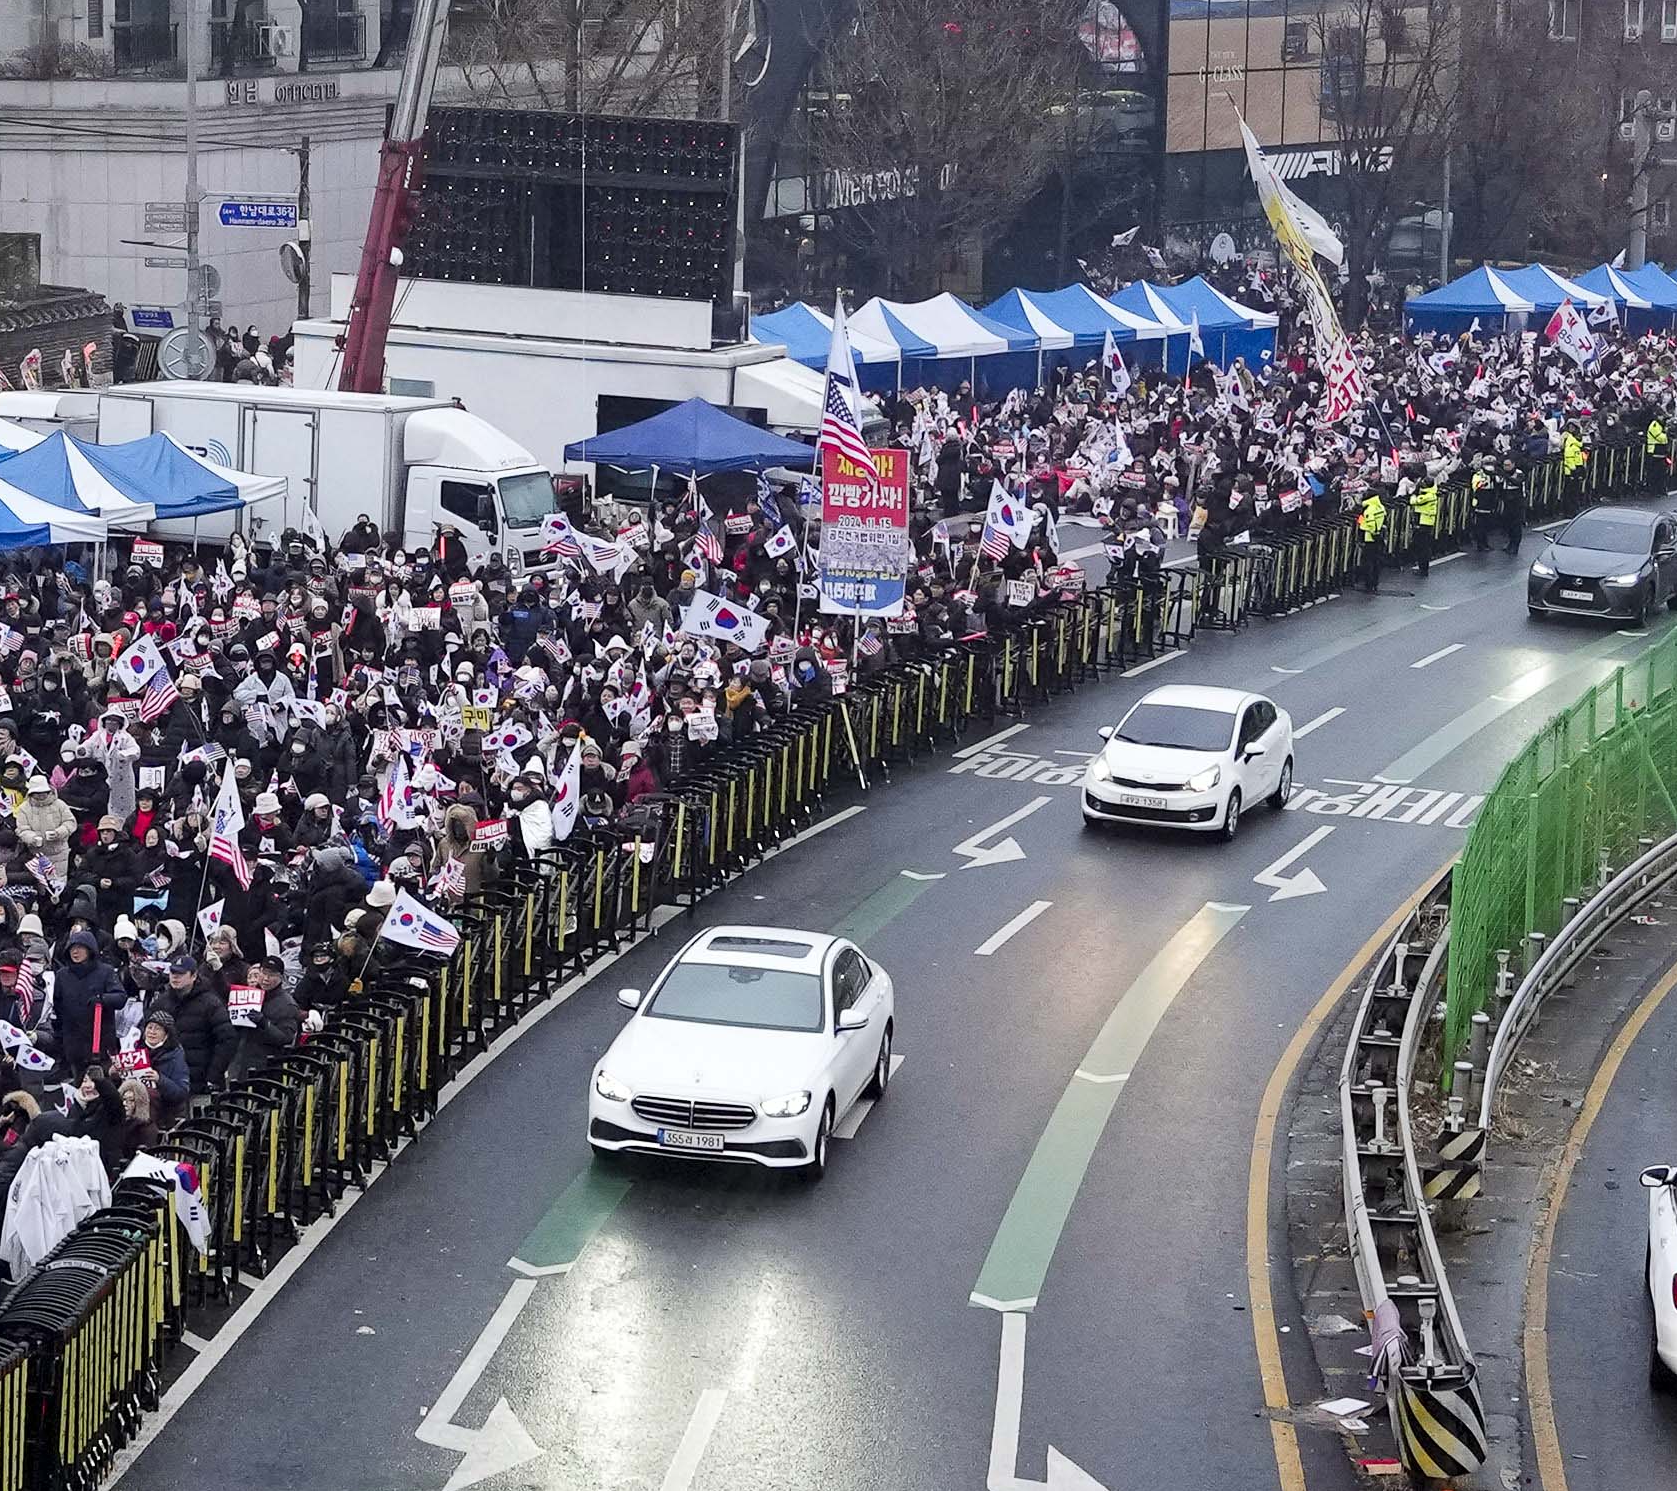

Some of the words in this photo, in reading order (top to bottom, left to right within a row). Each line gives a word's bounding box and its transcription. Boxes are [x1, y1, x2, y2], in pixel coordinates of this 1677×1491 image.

[463, 709, 490, 725] 구미
[229, 991, 262, 1005] 핵반대
[696, 1133, 720, 1147] 1981
